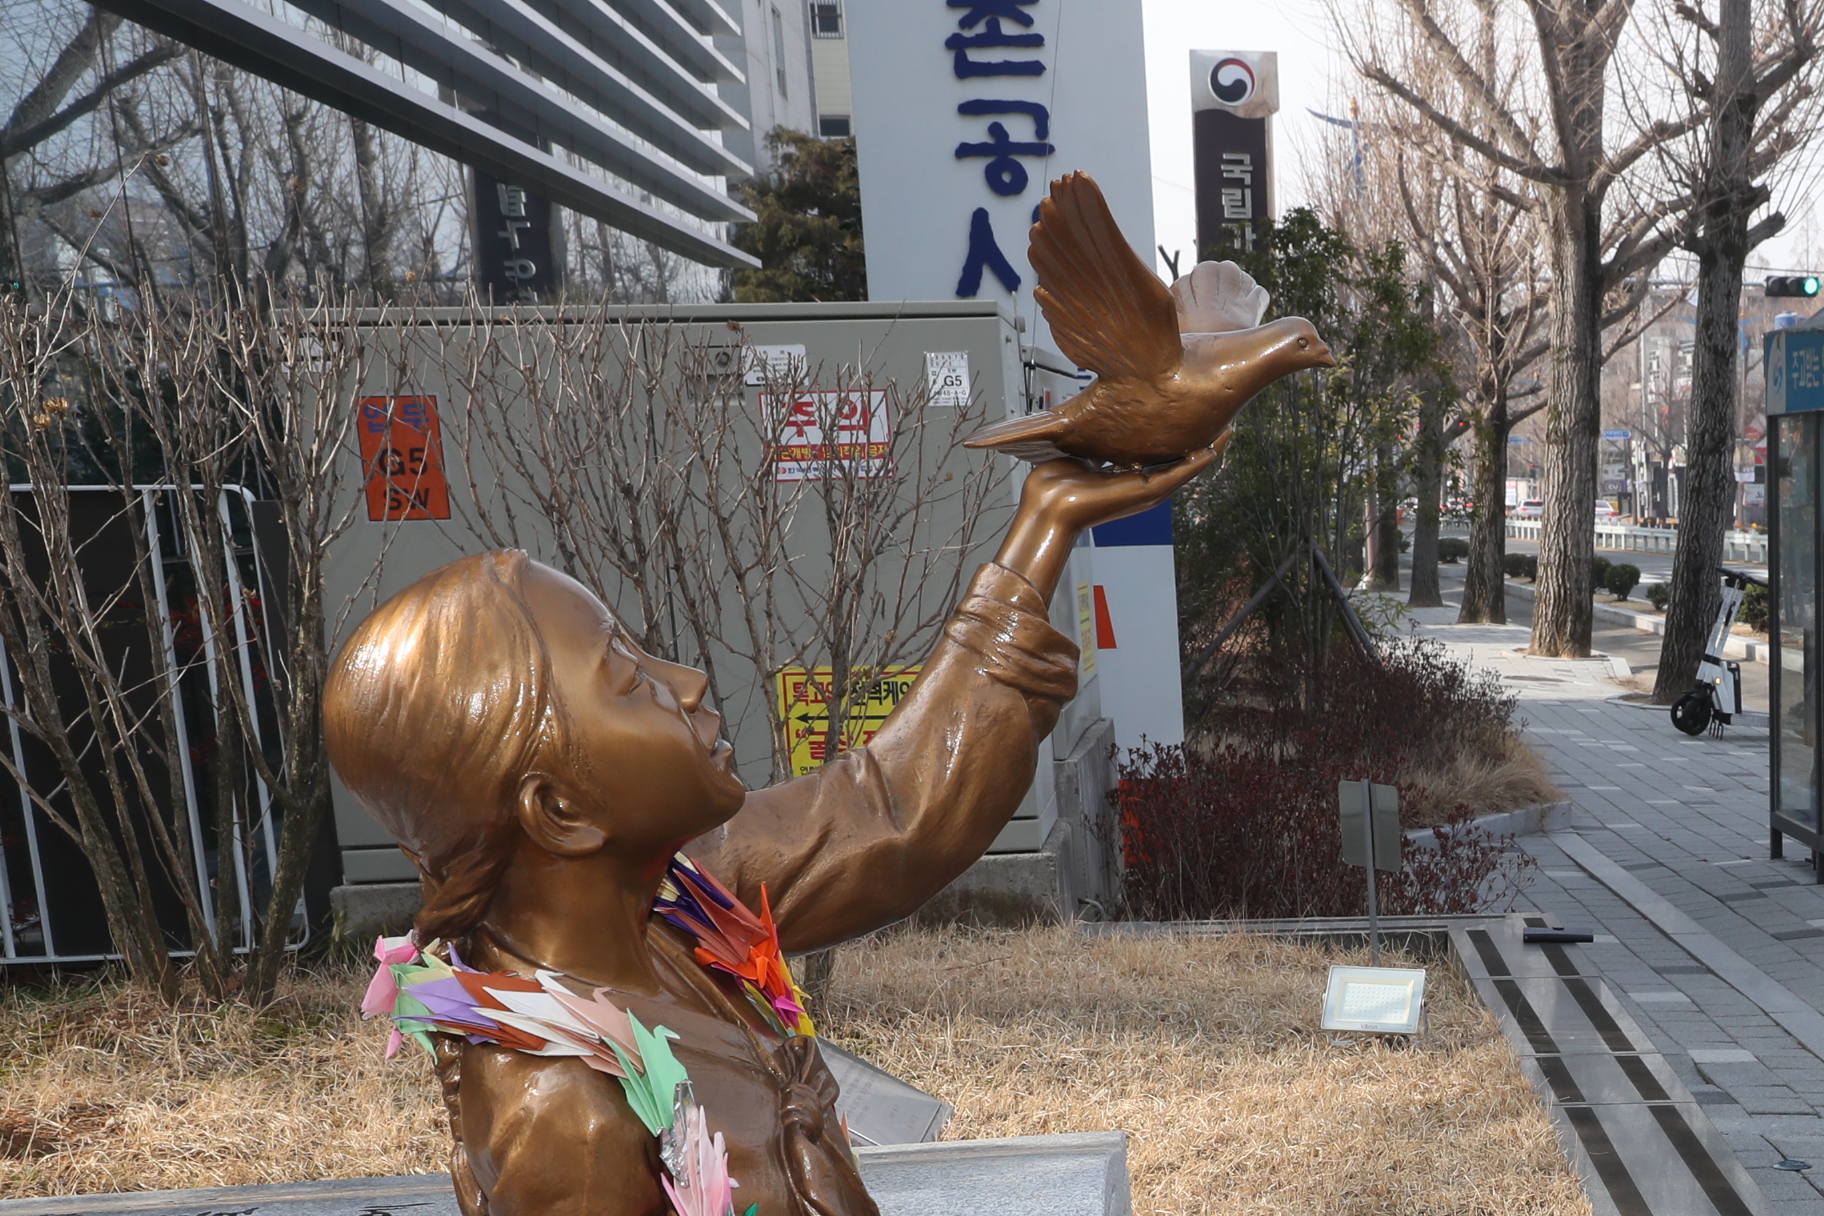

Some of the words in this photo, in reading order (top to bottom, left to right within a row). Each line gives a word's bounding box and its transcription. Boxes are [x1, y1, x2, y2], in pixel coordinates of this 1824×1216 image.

[943, 375, 963, 387] G5
[379, 447, 428, 477] G5
[383, 487, 430, 510] SW
